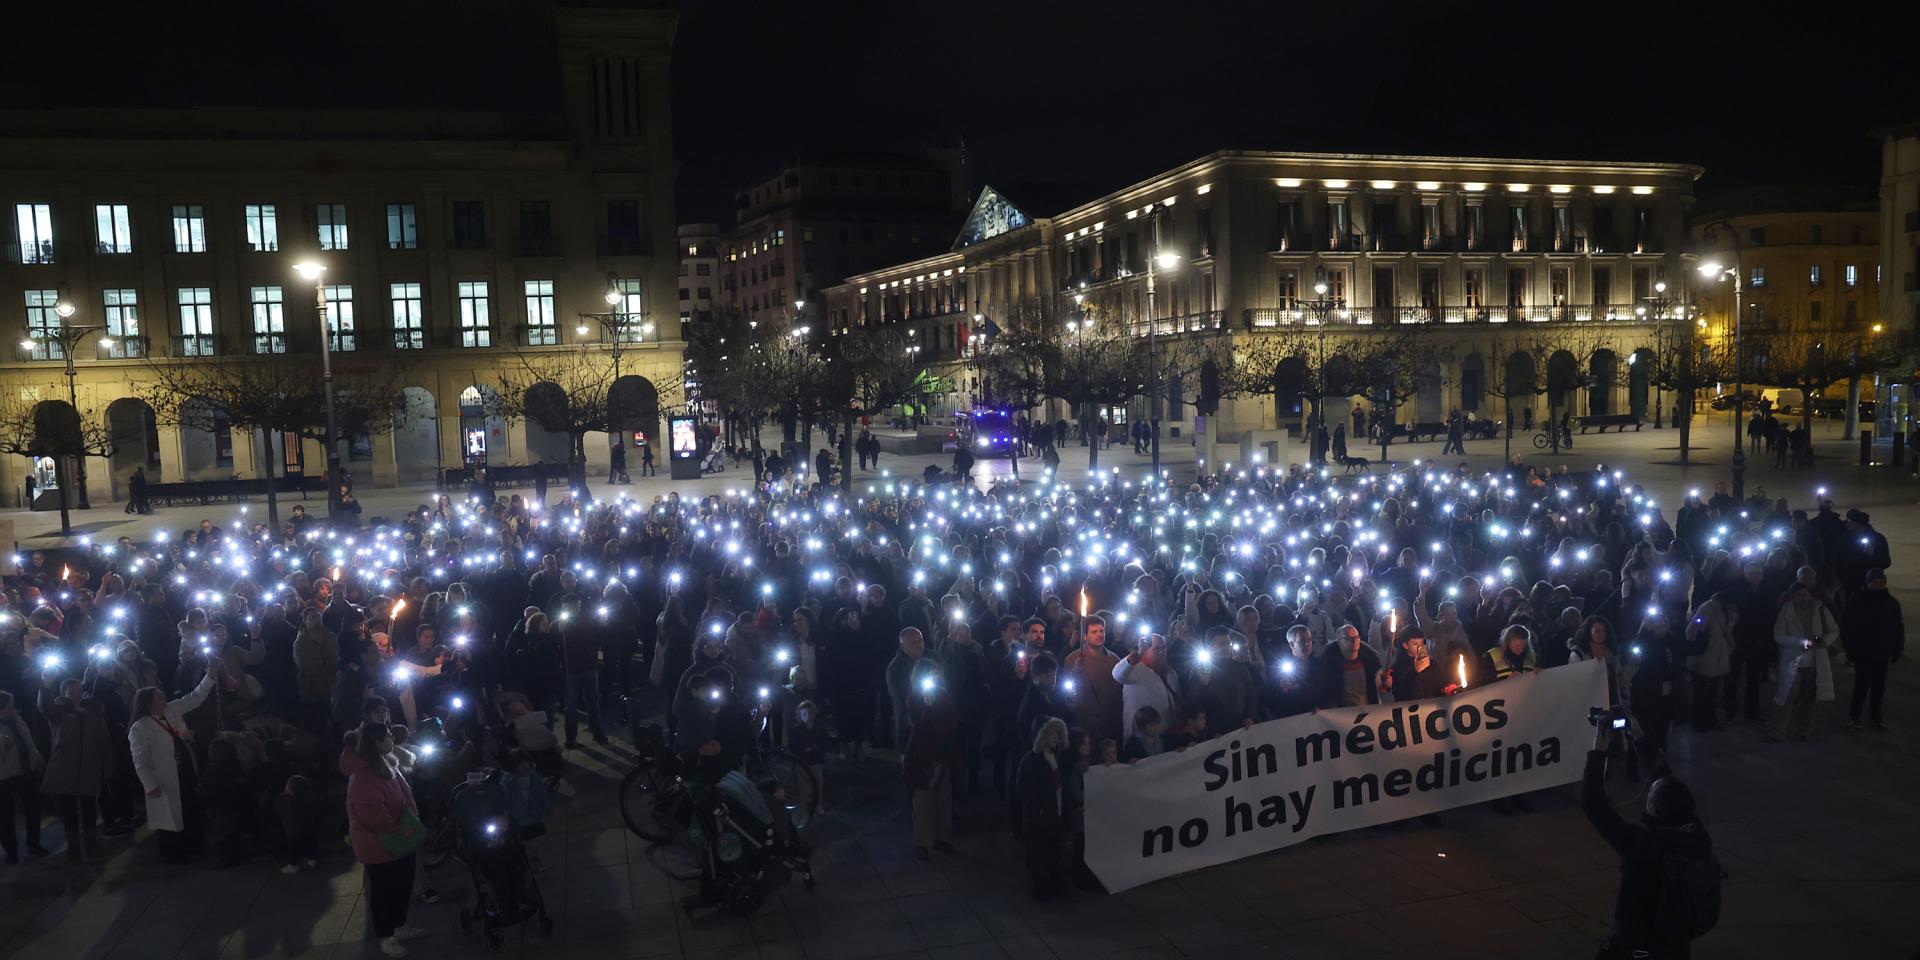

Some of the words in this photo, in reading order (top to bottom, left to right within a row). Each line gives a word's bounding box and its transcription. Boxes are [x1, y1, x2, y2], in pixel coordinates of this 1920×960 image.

[1143, 818, 1208, 858] no
[1225, 785, 1316, 837] hay
[1333, 736, 1561, 809] medicina
[1204, 738, 1277, 791] Sin
[1296, 699, 1508, 767] médicos
